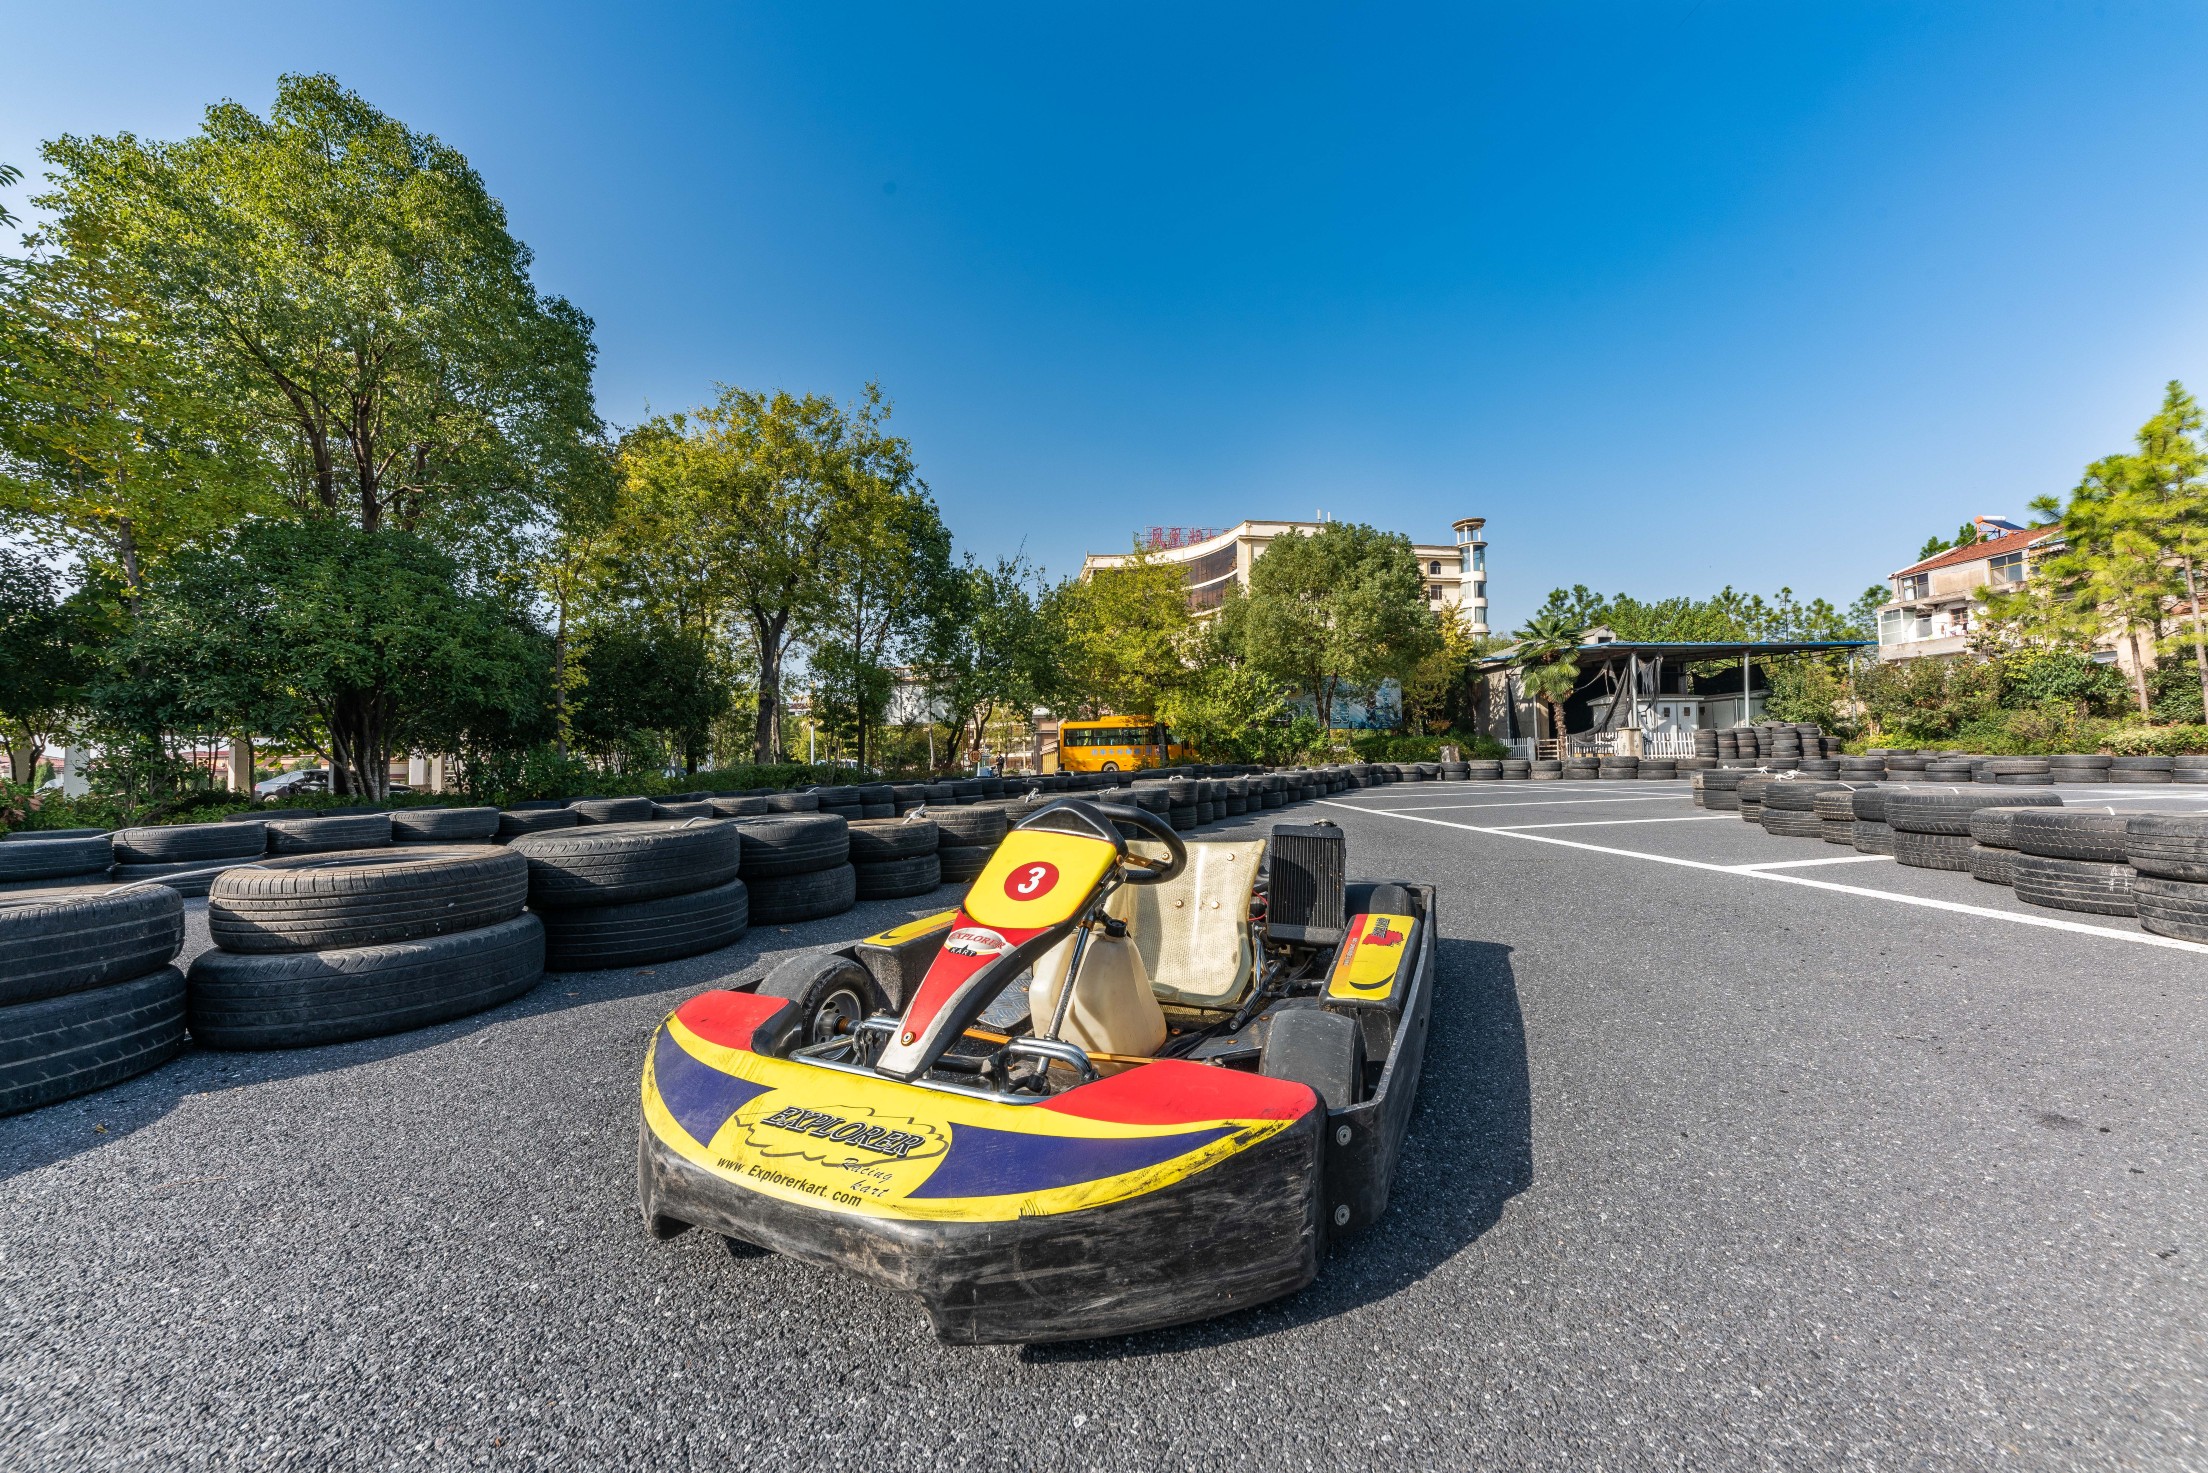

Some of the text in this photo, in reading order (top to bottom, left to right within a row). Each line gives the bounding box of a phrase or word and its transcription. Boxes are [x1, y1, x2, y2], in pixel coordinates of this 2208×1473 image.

[1017, 866, 1046, 894] 3
[949, 931, 1006, 949] EXPLORER
[950, 947, 974, 957] KART
[760, 1106, 926, 1157] EXPLORER
[836, 1158, 893, 1184] Racing
[850, 1179, 890, 1198] kart
